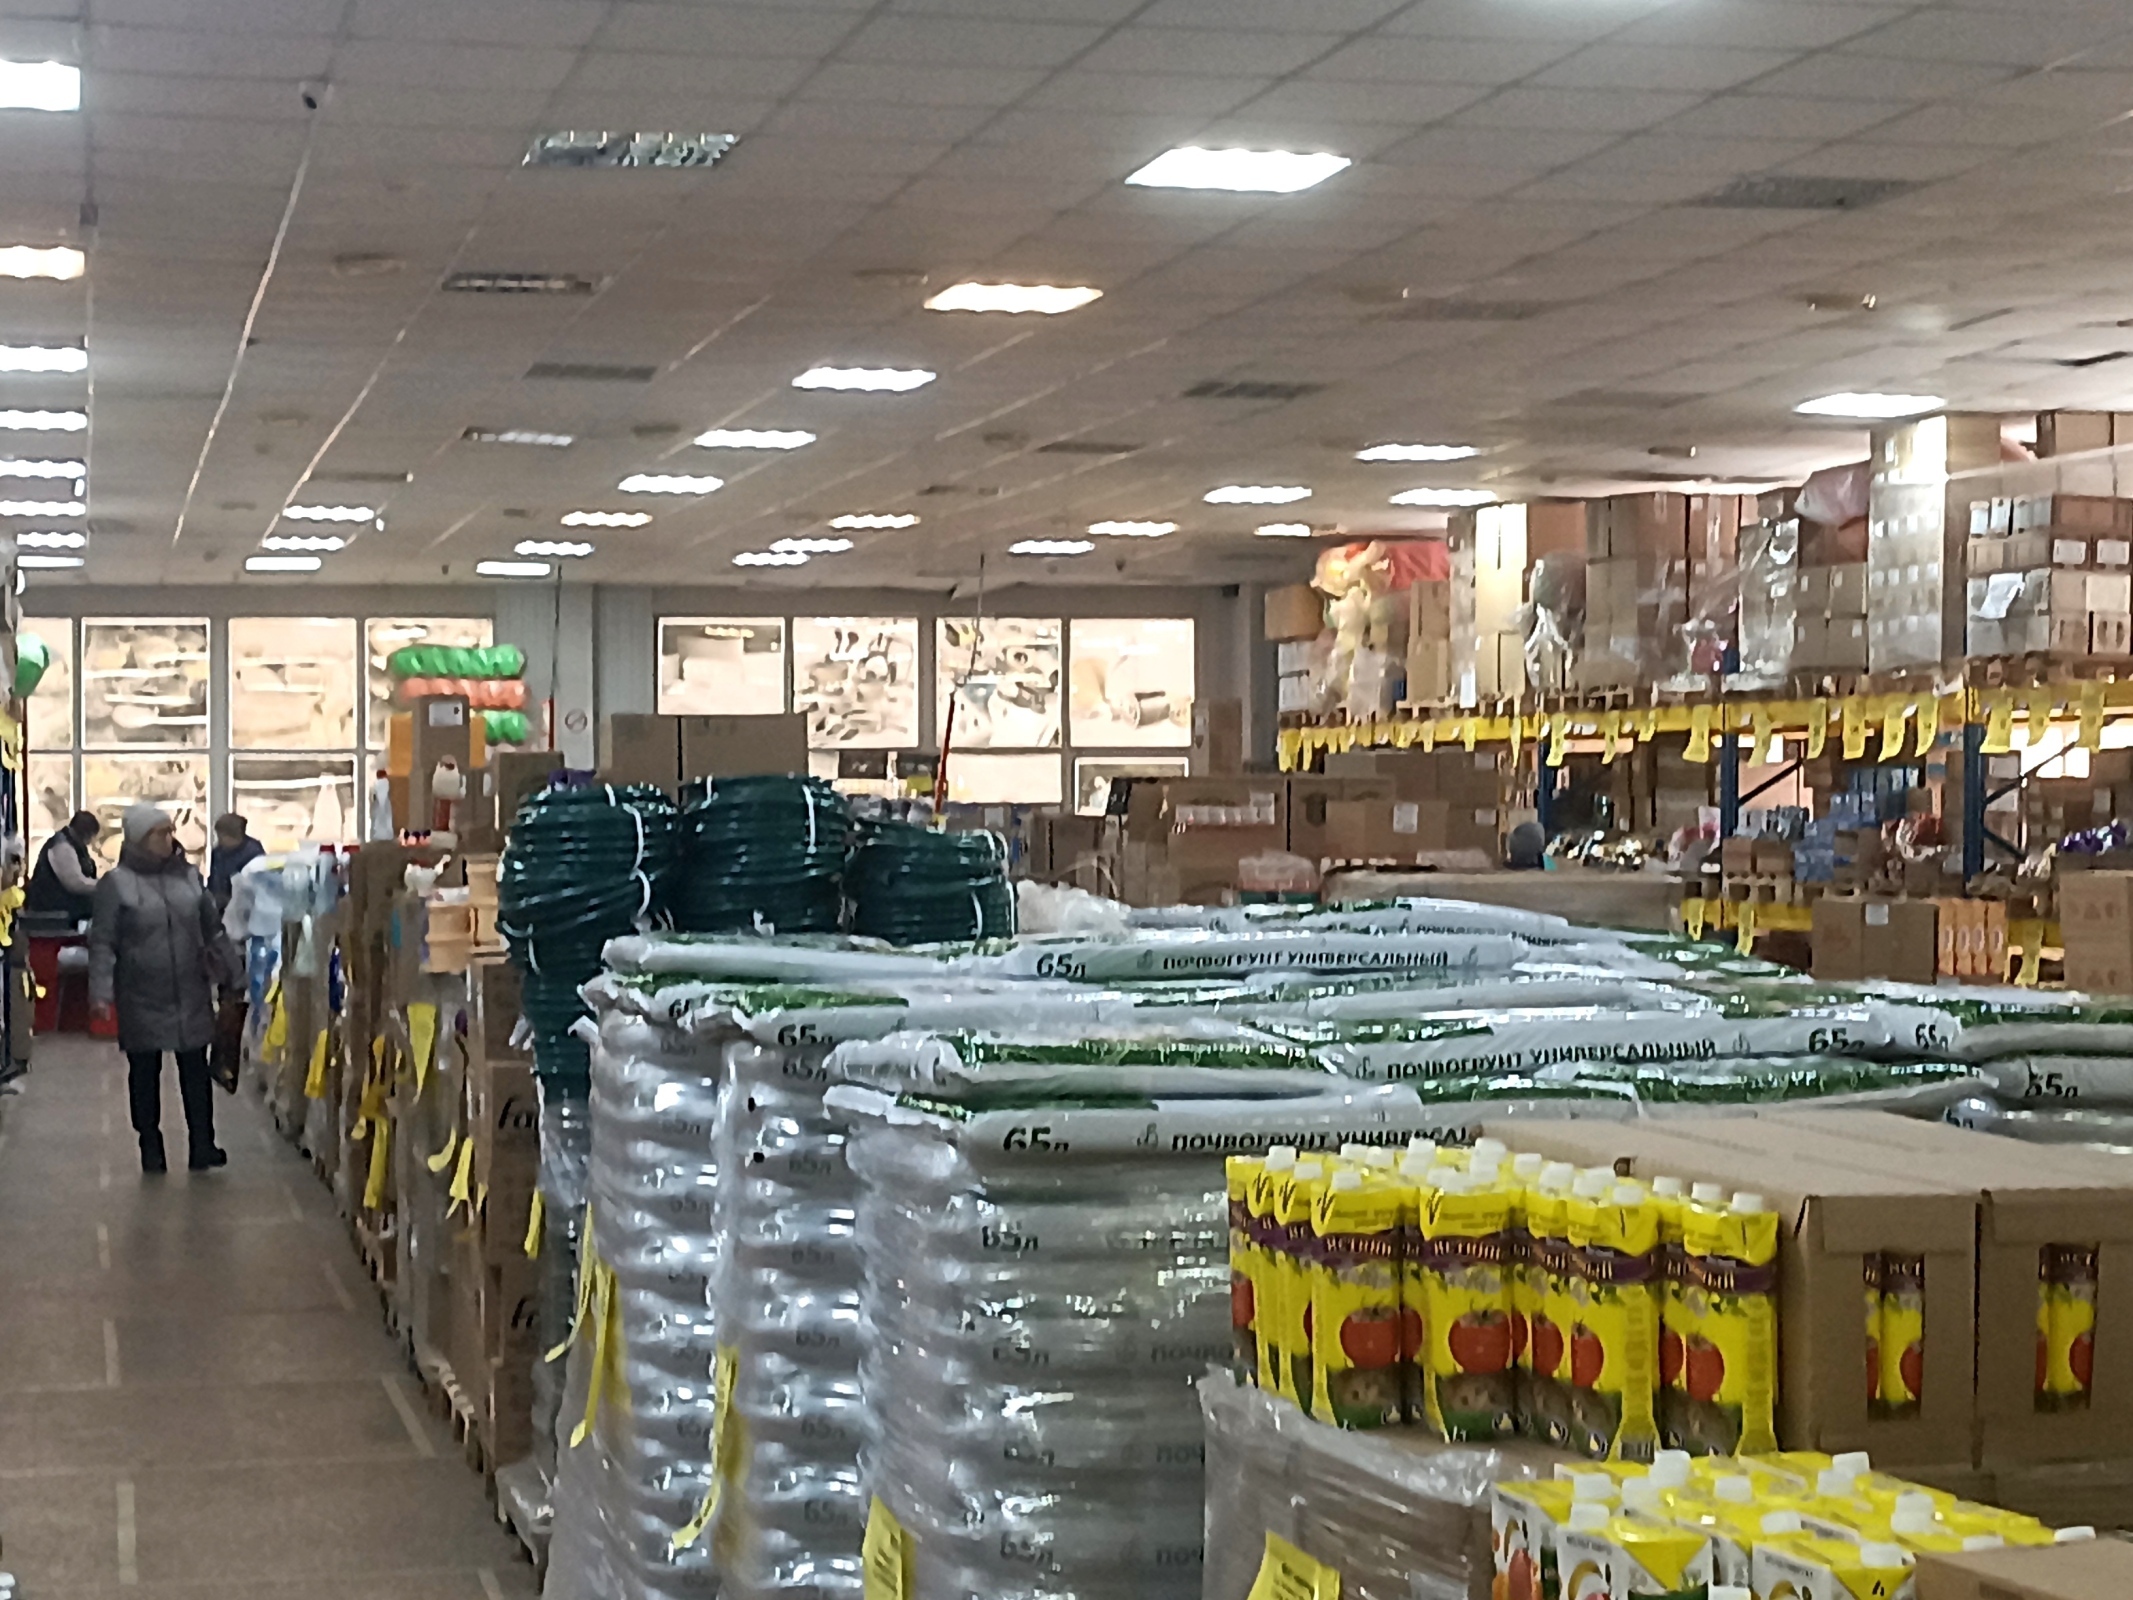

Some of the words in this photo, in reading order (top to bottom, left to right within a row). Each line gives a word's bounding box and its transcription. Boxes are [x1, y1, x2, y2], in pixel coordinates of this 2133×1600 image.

[1036, 953, 1086, 979] 65л
[777, 1023, 834, 1046] 65л
[1002, 1126, 1070, 1152] 65л
